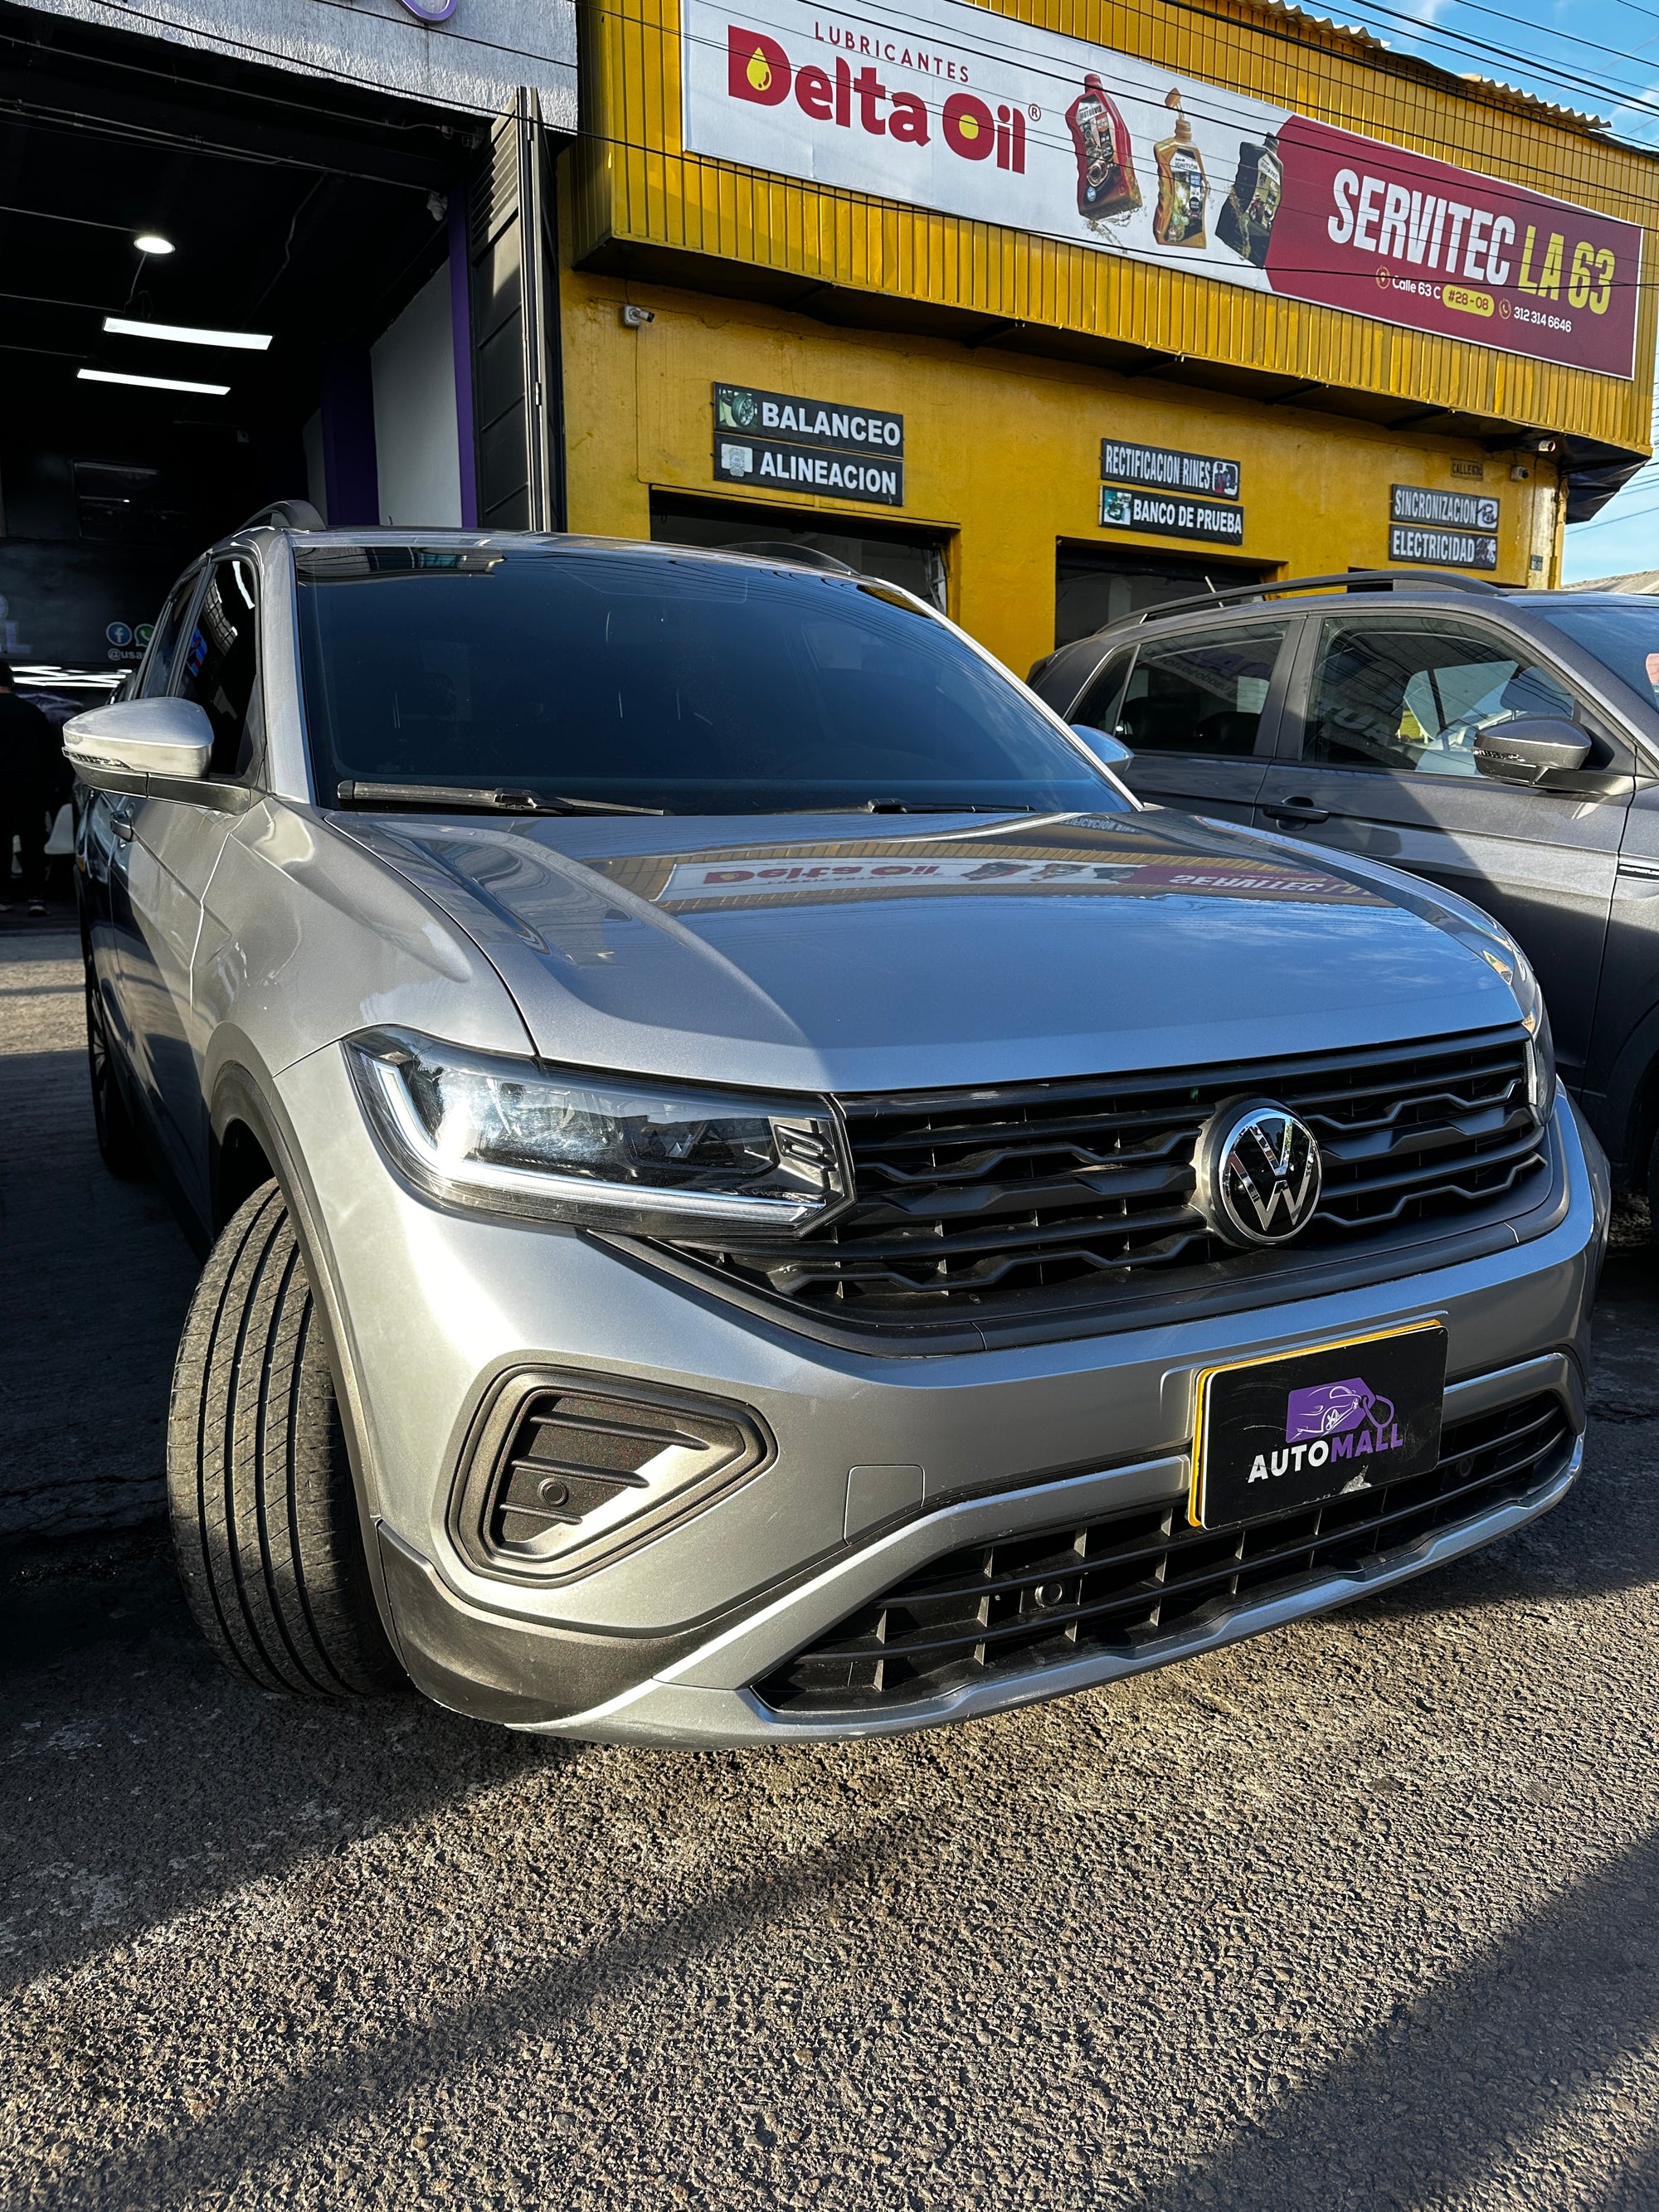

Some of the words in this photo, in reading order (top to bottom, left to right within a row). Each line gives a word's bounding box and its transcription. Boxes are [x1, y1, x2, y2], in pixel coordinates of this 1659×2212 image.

[815, 22, 970, 83] LUBRICANTES
[727, 25, 932, 148] Delta
[942, 92, 1026, 174] Oil
[1327, 168, 1515, 286] SERVITEC
[1518, 225, 1566, 301] LA
[1568, 241, 1615, 315] 63
[1392, 275, 1416, 294] Calle
[1418, 283, 1432, 296] 63
[1433, 287, 1442, 299] C
[1548, 313, 1572, 333] 6646
[761, 401, 901, 446] BALANCEO
[760, 451, 897, 495] ALINEACION
[1105, 444, 1180, 484] RECTIFICACION
[1182, 459, 1211, 489] RINES
[1133, 498, 1175, 525] BANCO
[1178, 505, 1194, 528] DE
[1196, 509, 1242, 534] PRUEBA
[1394, 489, 1477, 524] SINCRONIZACION
[1393, 530, 1475, 563] ELECTRICIDAD
[108, 648, 145, 661] @usa
[1248, 1424, 1404, 1484] AUTOMALL
